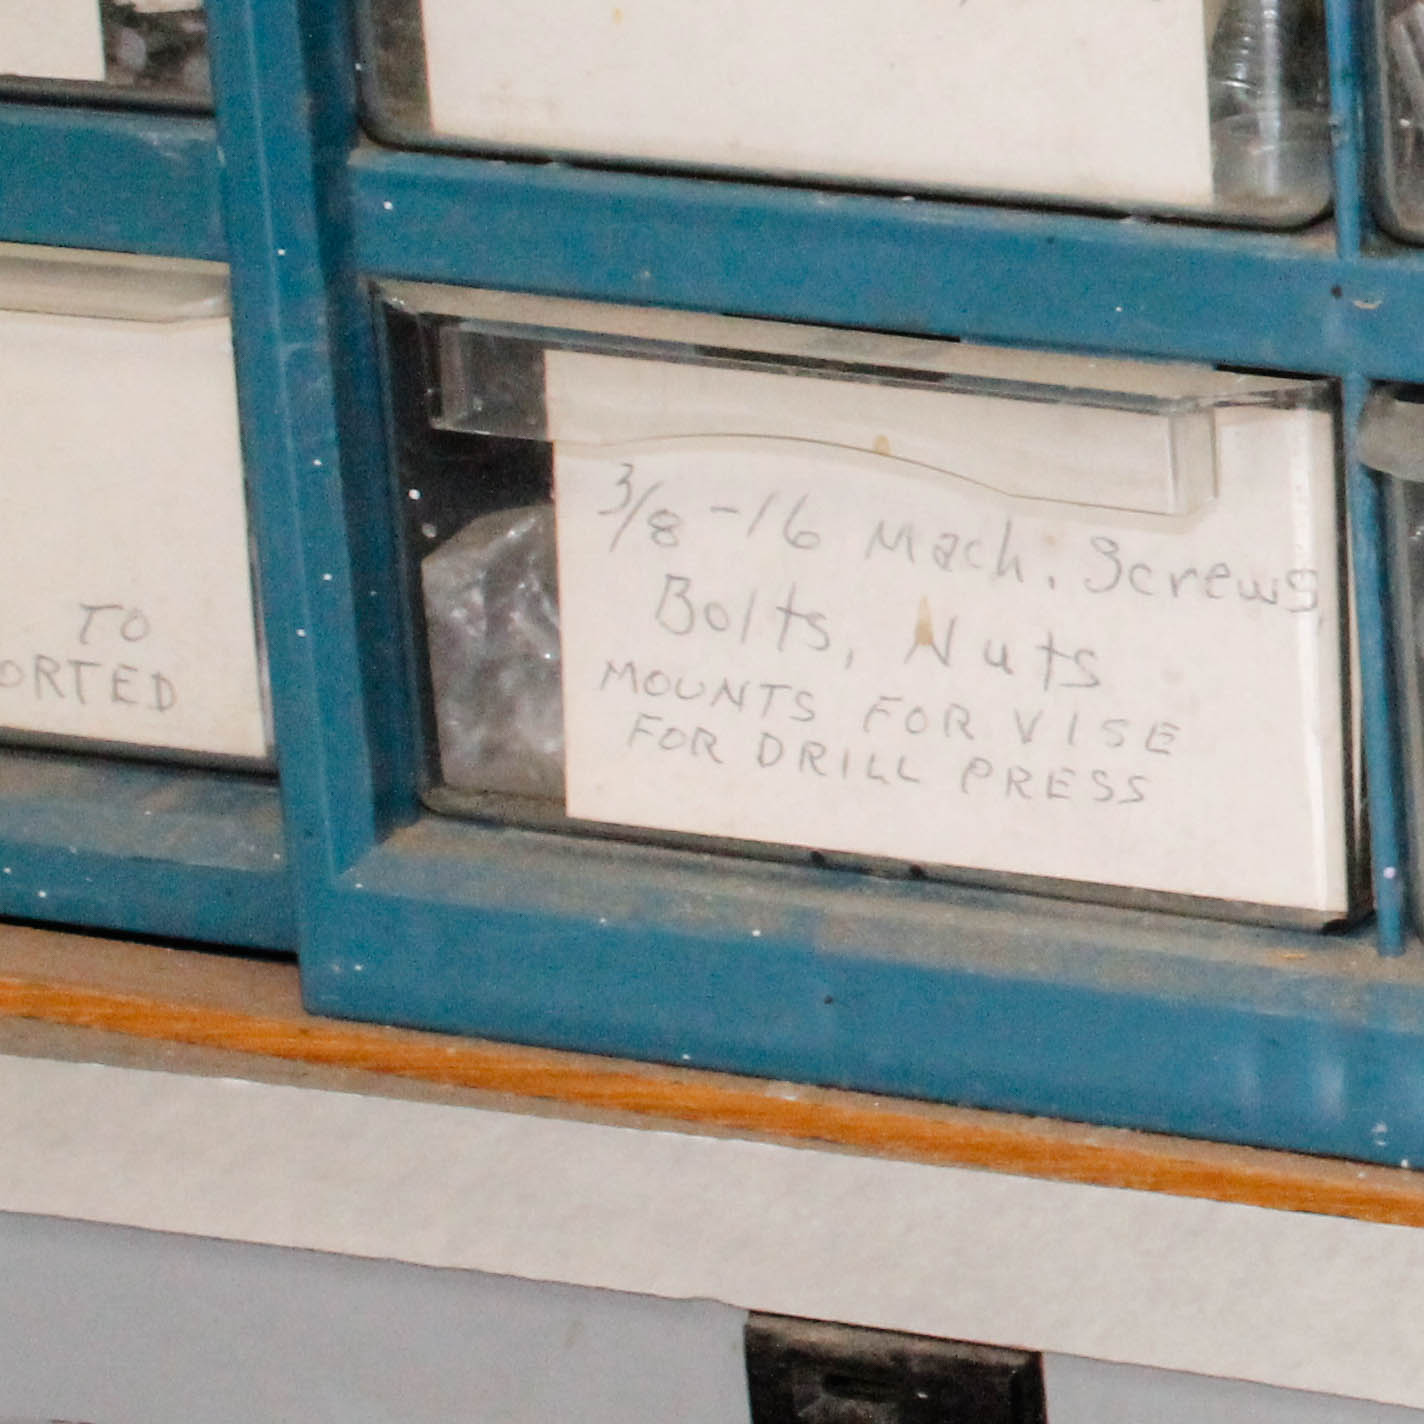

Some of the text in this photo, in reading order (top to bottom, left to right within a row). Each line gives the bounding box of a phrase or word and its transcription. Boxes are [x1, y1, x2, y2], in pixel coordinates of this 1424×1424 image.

[599, 462, 821, 553] 3/8-16
[864, 517, 1058, 592] Mach.
[79, 602, 151, 645] TO
[654, 574, 1102, 693] Bolts, Nuts
[0, 653, 178, 713] ORTED
[599, 660, 1181, 757] MOUNTS FOR VISE
[627, 714, 1151, 807] FOR DRILL PRESS
